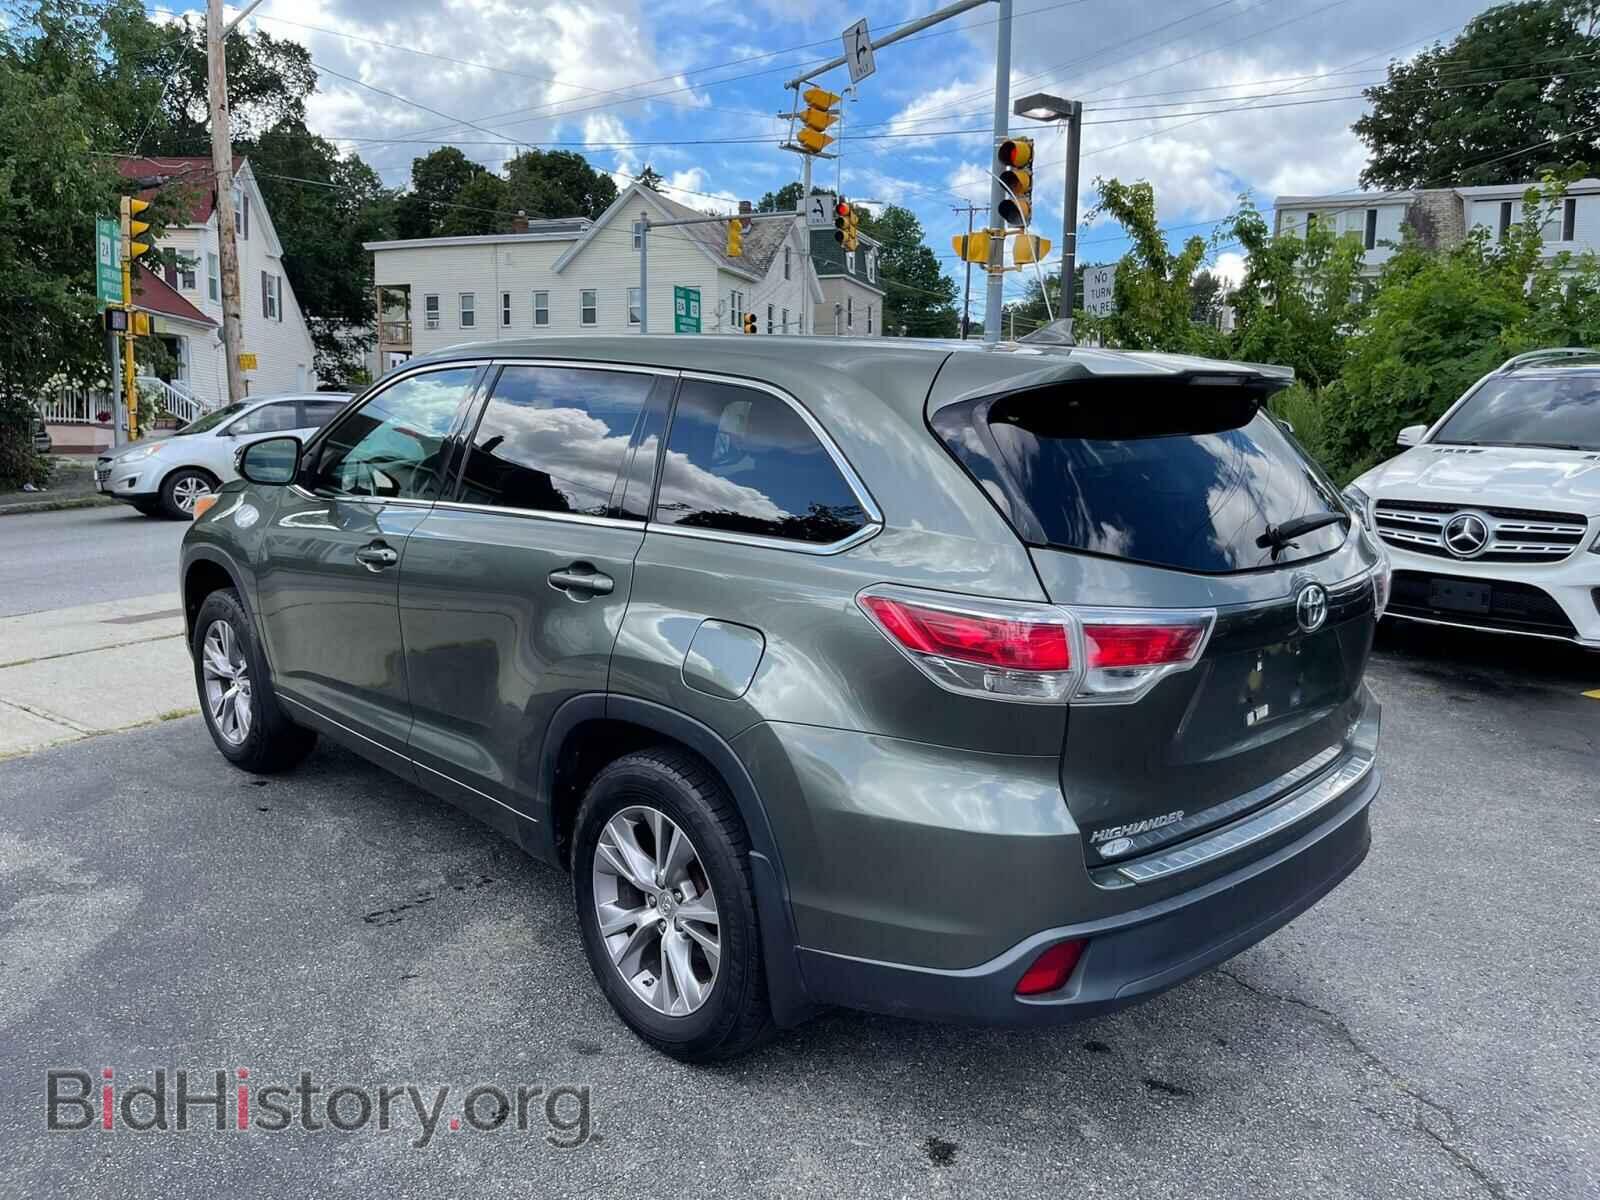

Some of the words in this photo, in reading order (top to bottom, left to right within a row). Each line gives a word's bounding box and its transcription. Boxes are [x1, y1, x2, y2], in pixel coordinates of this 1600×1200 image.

[1095, 271, 1108, 284] NO
[1091, 287, 1112, 299] TURN
[1087, 303, 1098, 313] ON
[1089, 810, 1185, 843] HIGHLANDER
